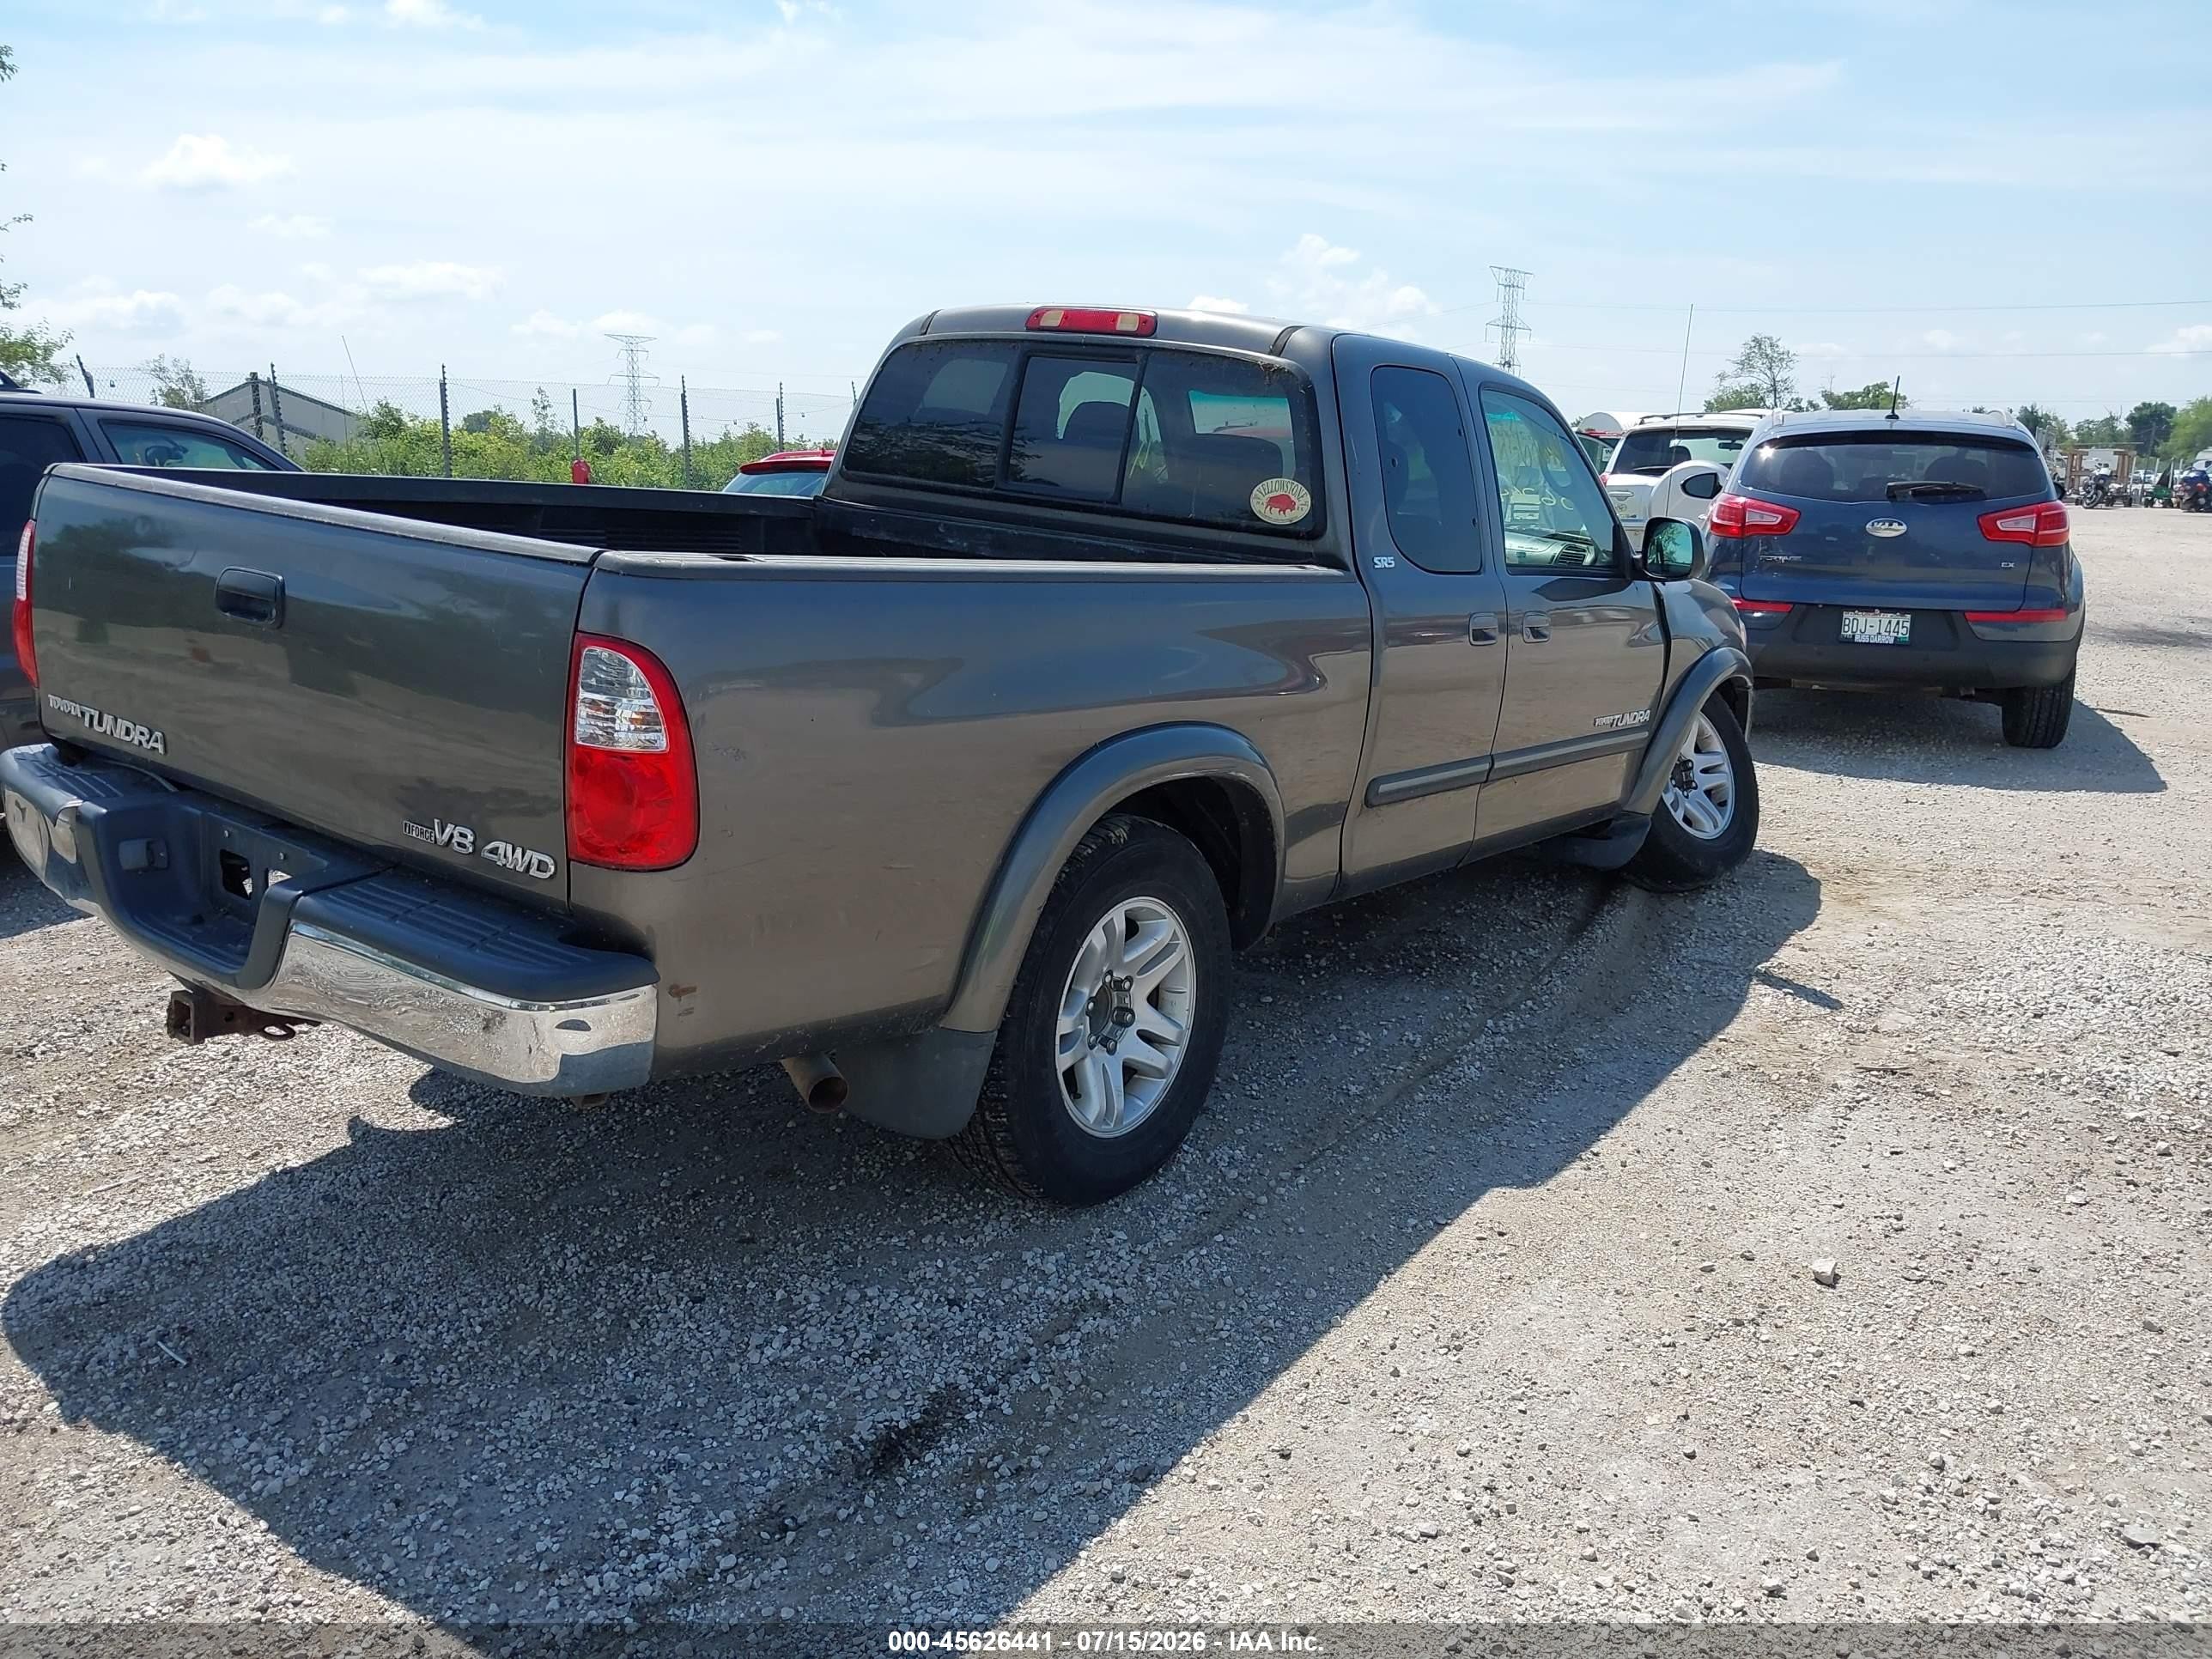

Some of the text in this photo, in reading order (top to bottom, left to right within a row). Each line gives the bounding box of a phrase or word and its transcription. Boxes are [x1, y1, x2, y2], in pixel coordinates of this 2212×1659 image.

[1256, 480, 1309, 507] YELLOWSTONE
[1373, 556, 1395, 568] SR5
[1843, 617, 1909, 635] BDJ-1445
[1855, 634, 1869, 643] RUSS
[1870, 635, 1895, 644] DARROW
[48, 694, 166, 756] TOYOTA TUNDRA
[1611, 709, 1651, 728] TUNDRA
[434, 818, 476, 854] V8
[481, 841, 556, 879] 4WD
